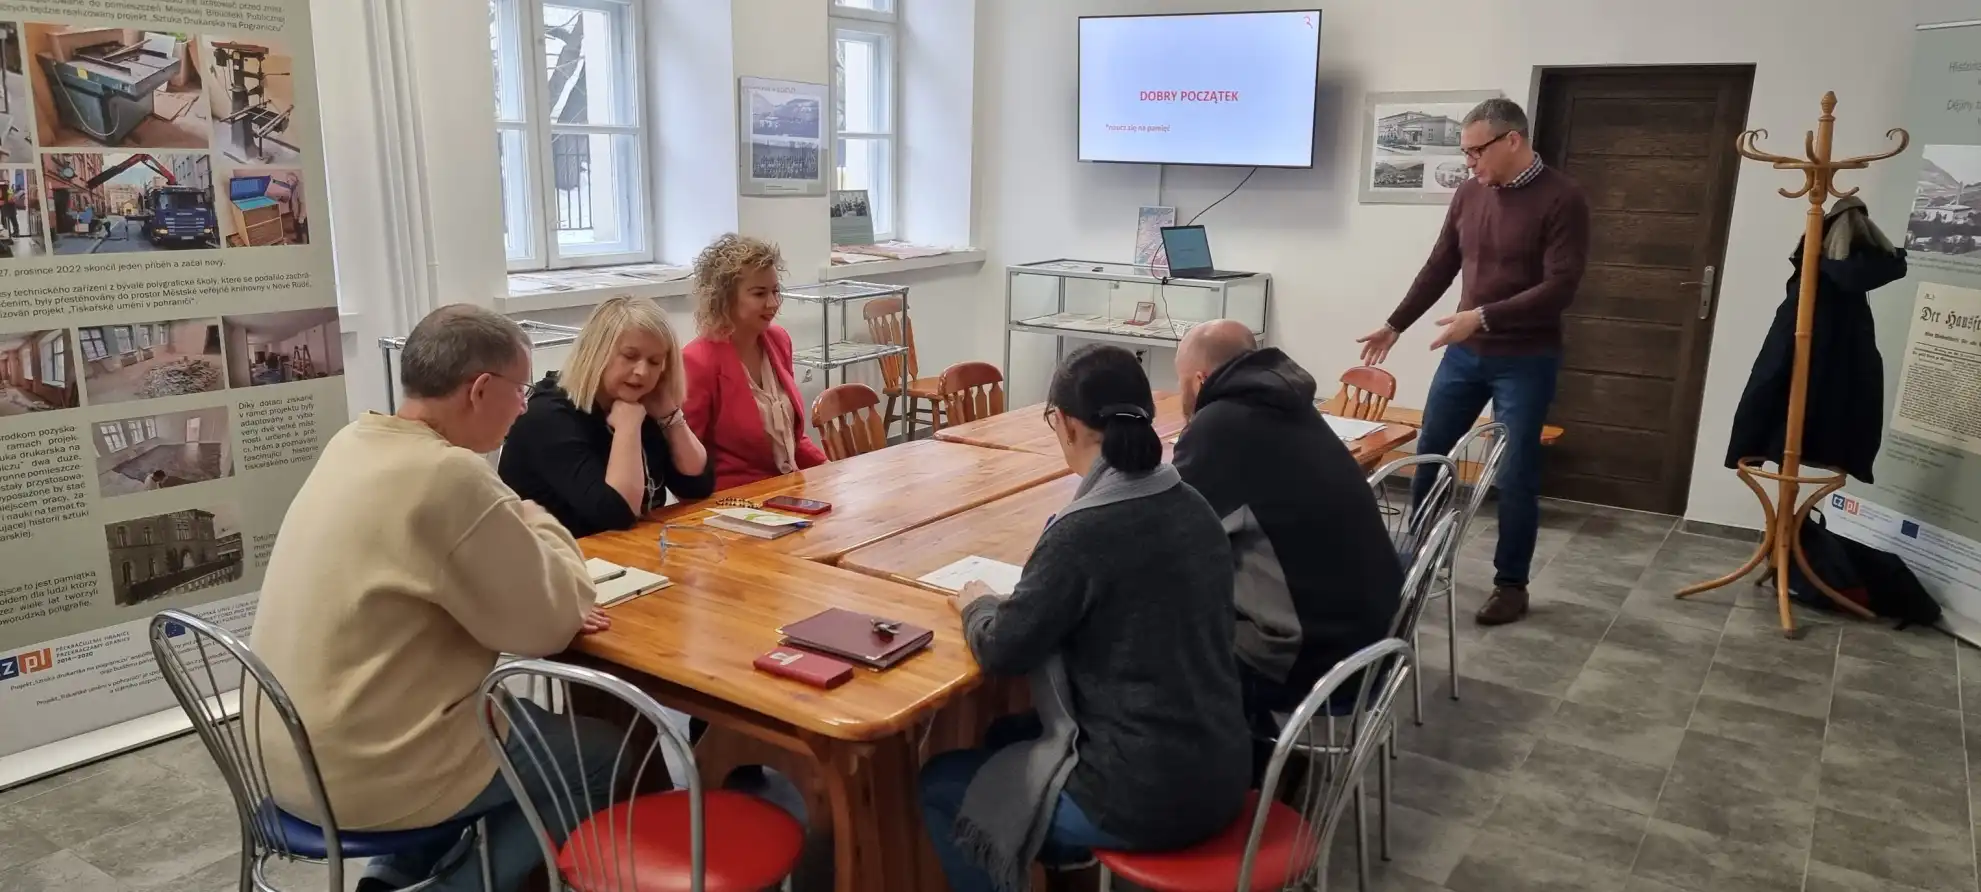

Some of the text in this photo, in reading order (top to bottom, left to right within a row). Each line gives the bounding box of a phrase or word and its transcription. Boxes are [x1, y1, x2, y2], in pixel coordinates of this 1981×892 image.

[1140, 91, 1238, 104] DOBRY POCZĄTEK
[56, 264, 81, 274] 2022
[118, 292, 128, 300] do
[0, 431, 36, 442] rodkom
[0, 500, 38, 512] iejscem
